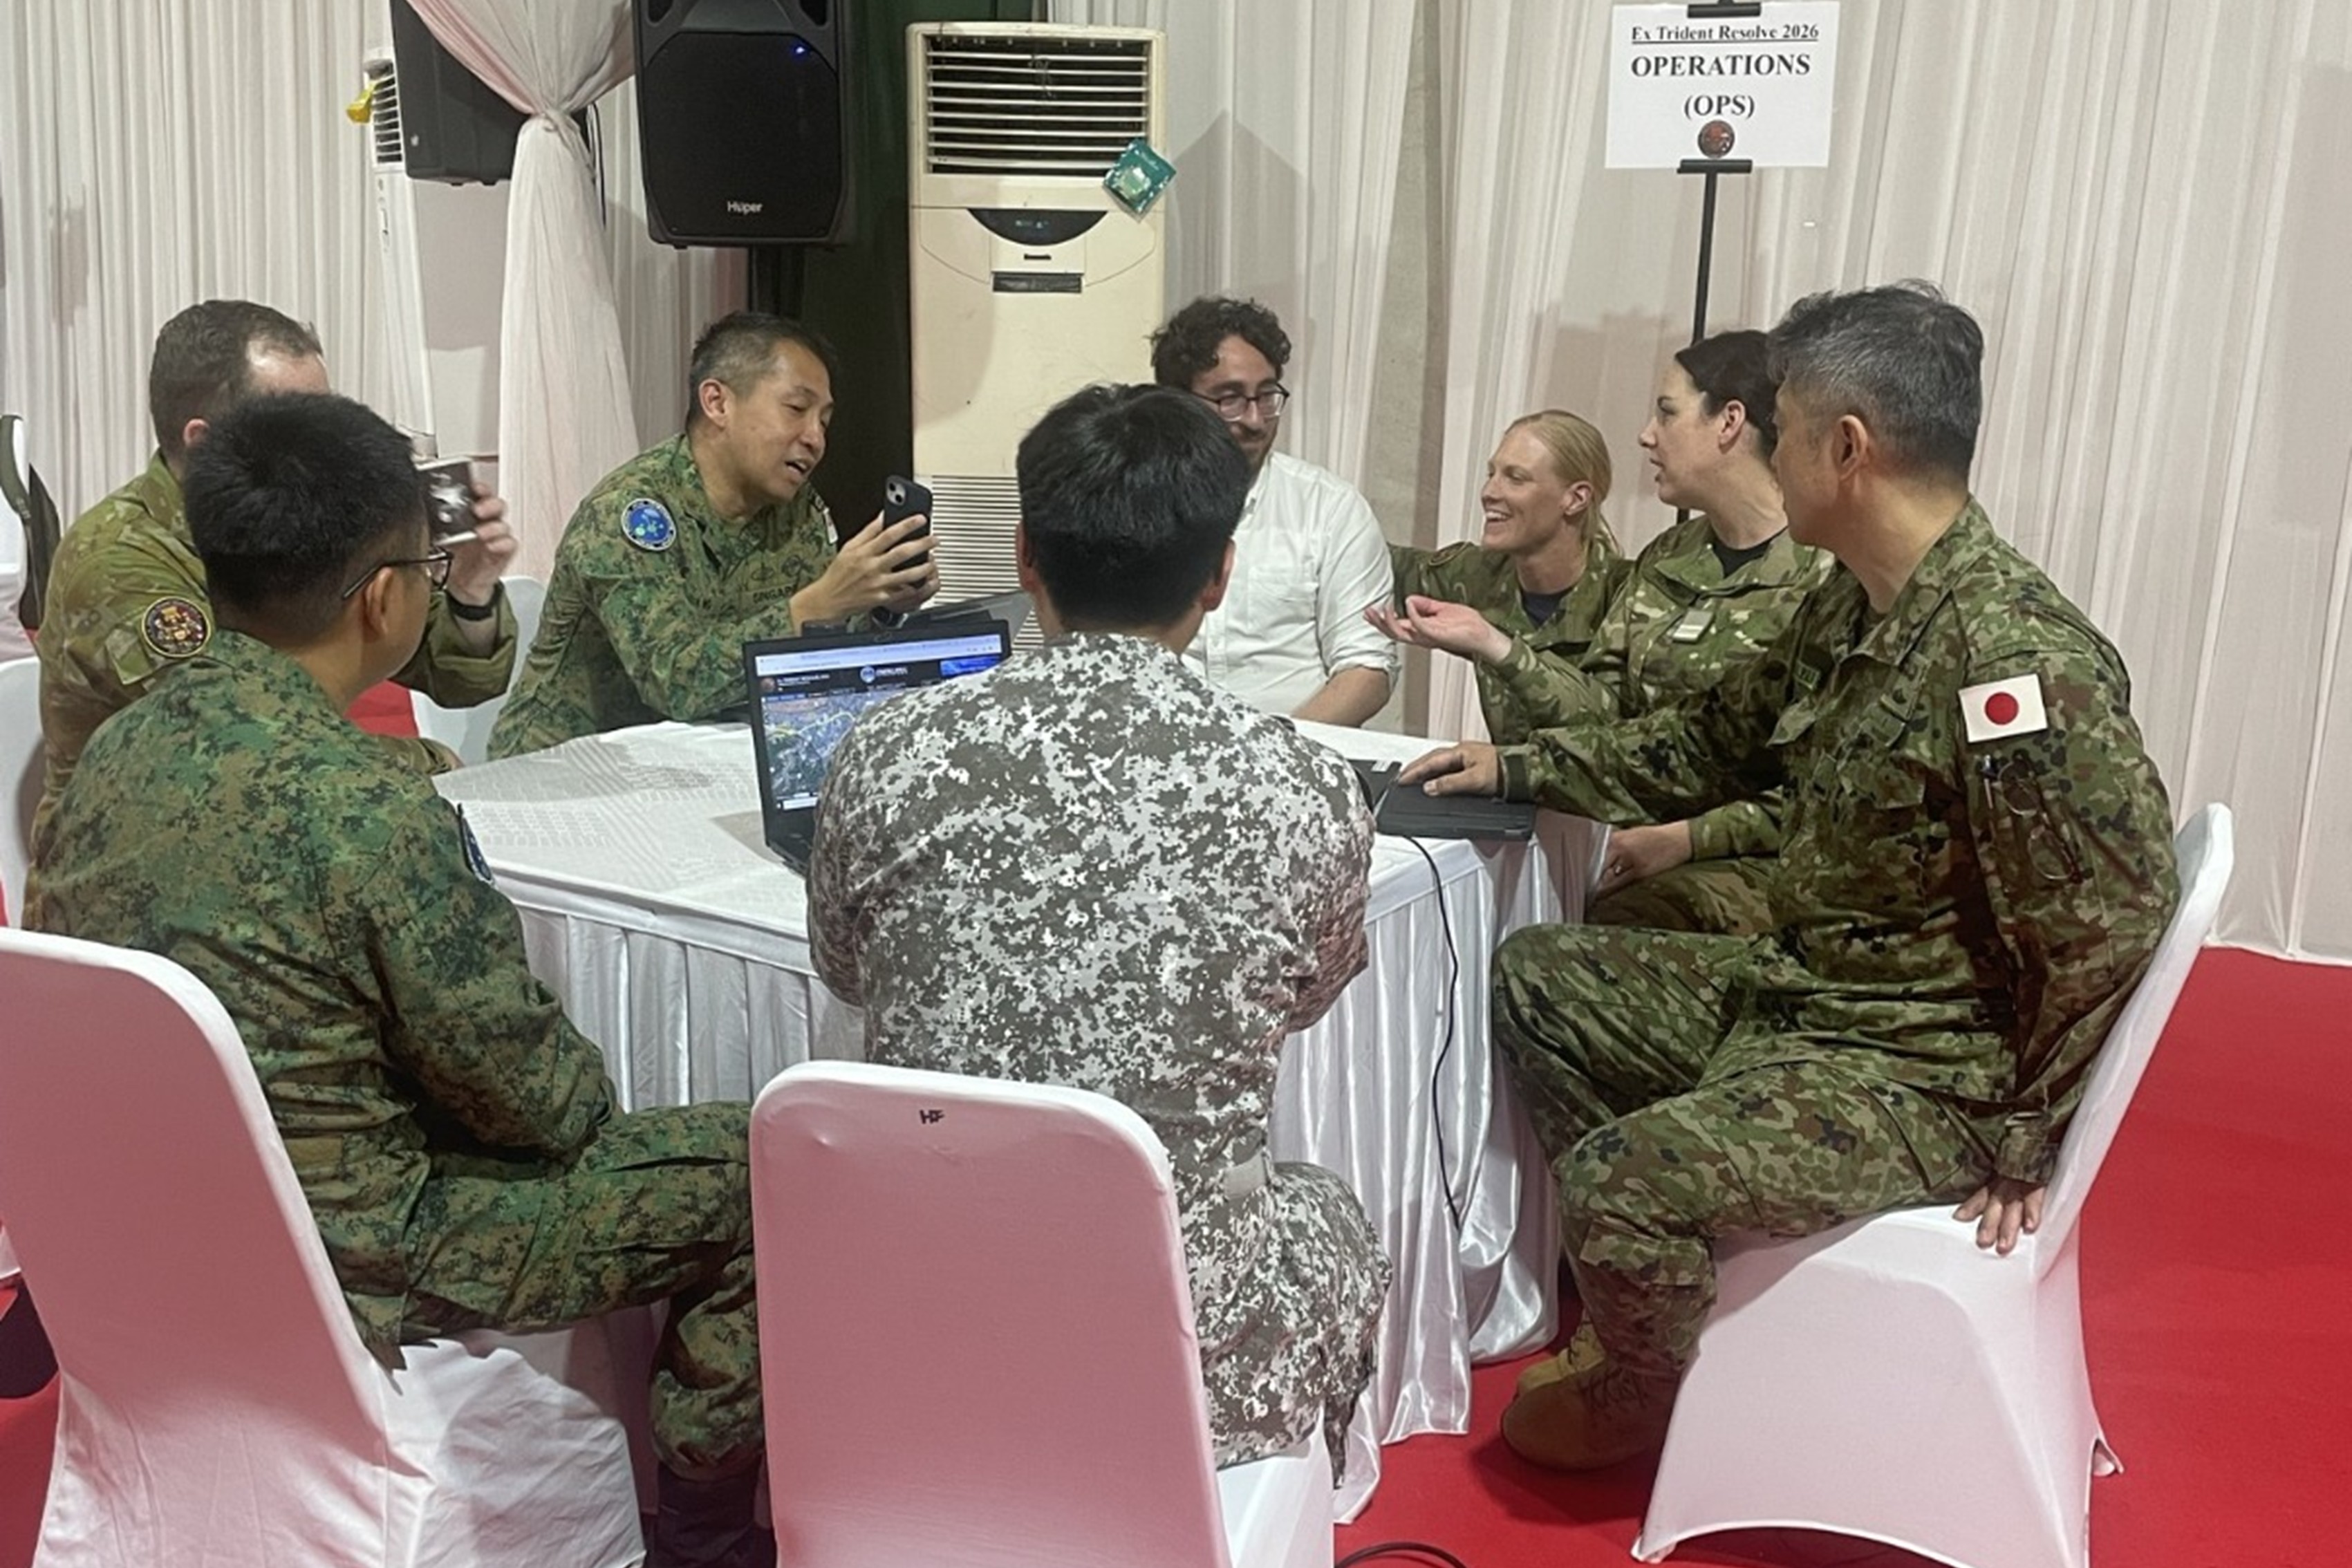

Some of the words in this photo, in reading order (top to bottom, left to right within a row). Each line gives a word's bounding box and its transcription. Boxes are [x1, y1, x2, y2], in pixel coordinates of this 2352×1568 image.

[1632, 26, 1651, 40] Ex
[1656, 25, 1713, 40] Trident
[1719, 24, 1778, 39] Resolve
[1782, 24, 1820, 39] 2026
[1631, 54, 1811, 77] OPERATIONS
[1684, 94, 1755, 119] (OPS)
